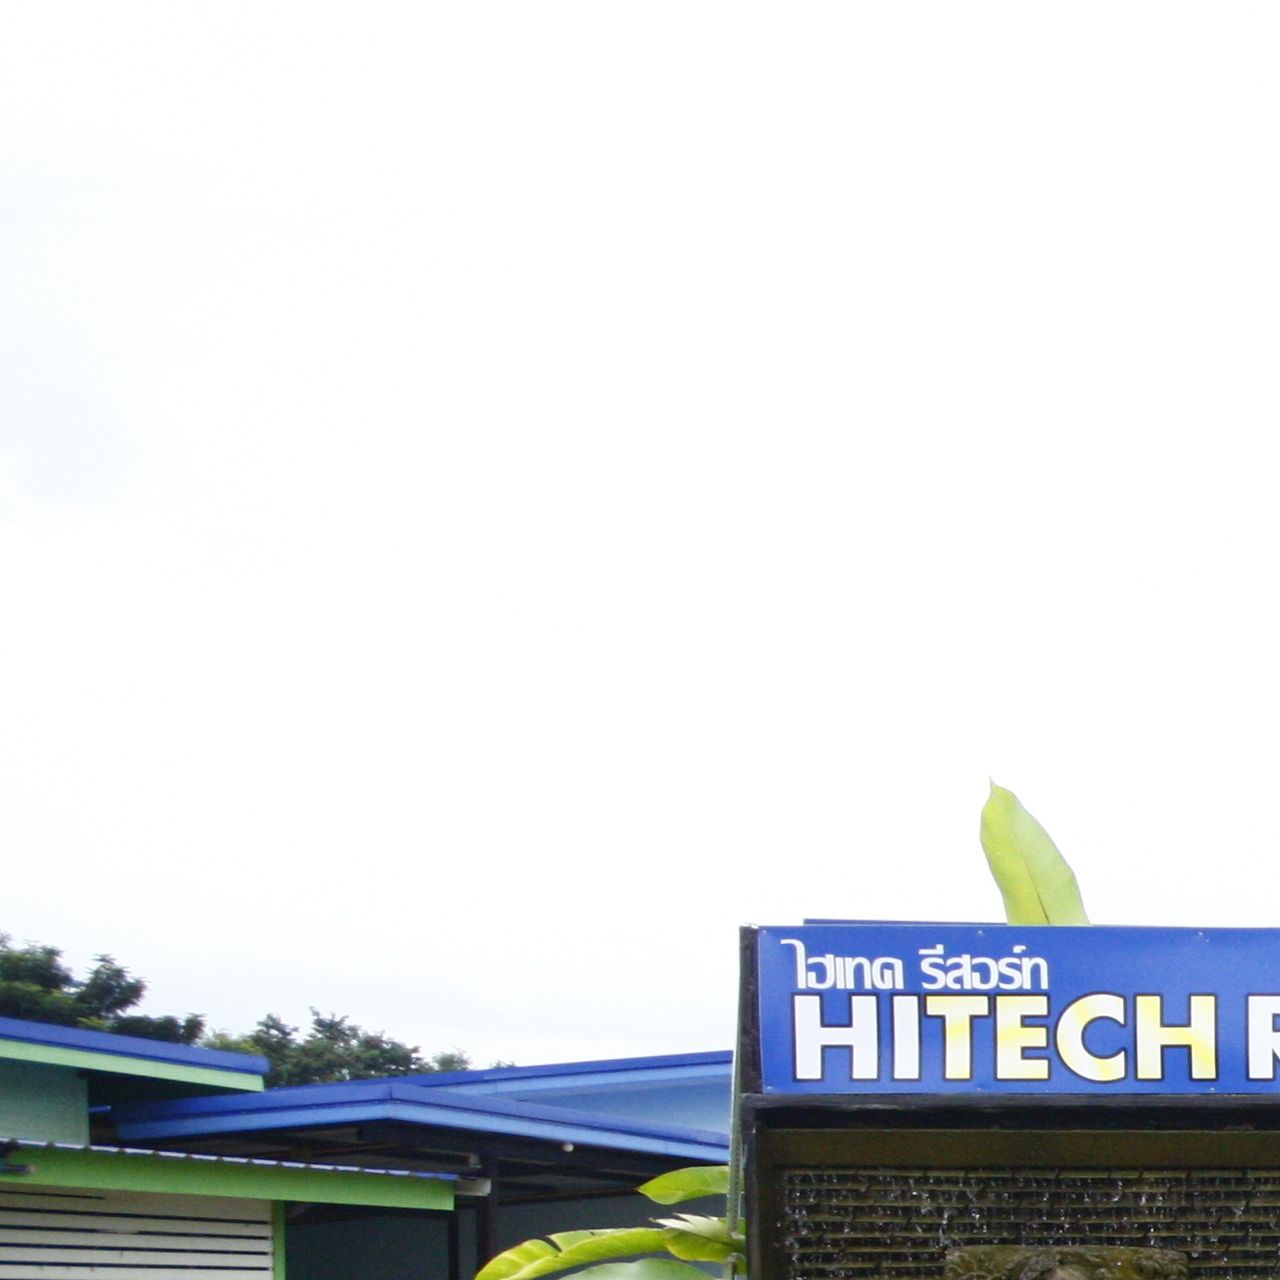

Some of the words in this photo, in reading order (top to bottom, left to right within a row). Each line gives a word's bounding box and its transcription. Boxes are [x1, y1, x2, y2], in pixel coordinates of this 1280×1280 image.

[918, 943, 1049, 990] รีสอร์ท
[792, 993, 1219, 1082] HITECH
